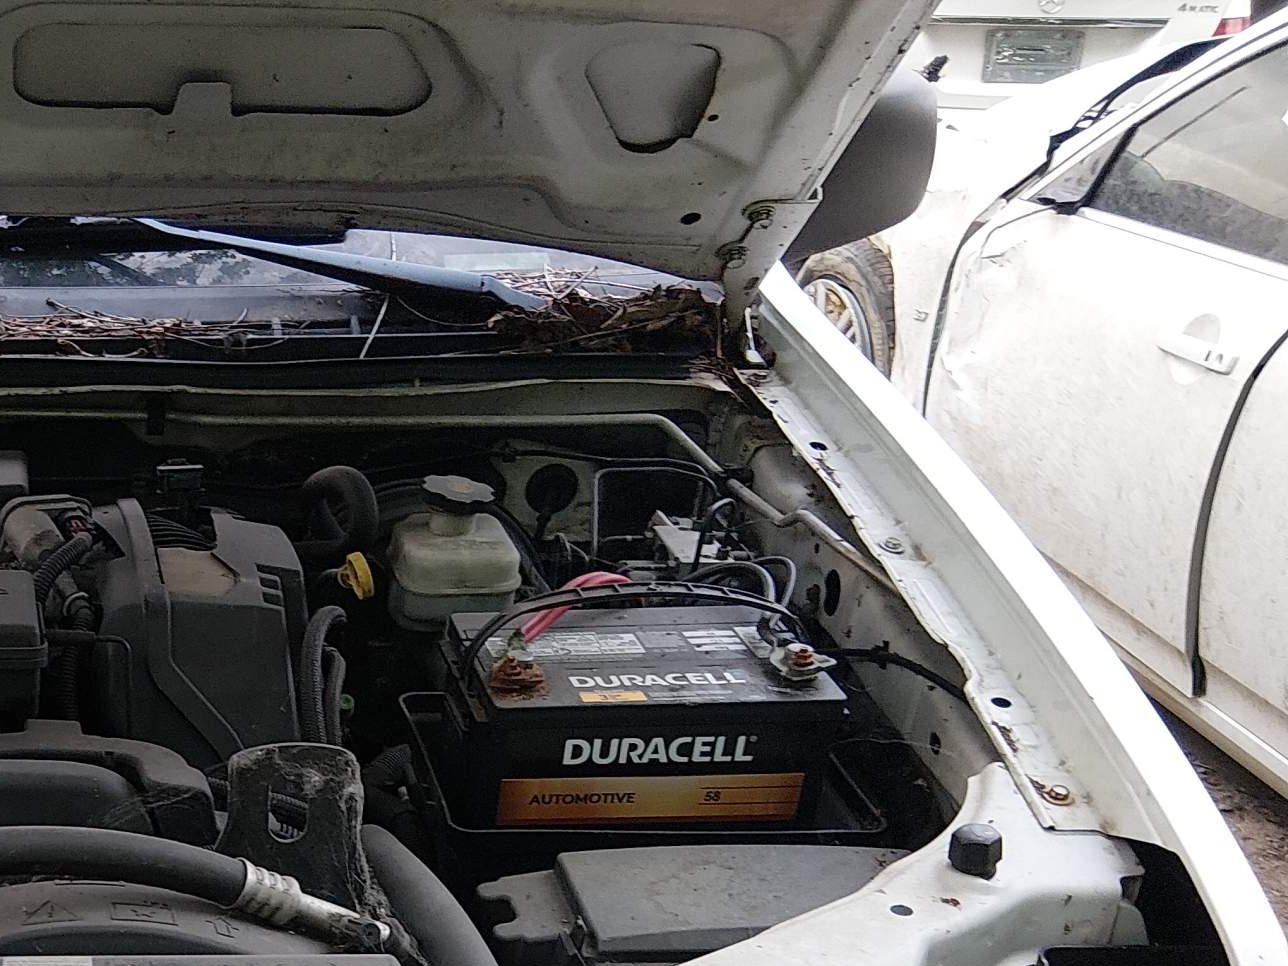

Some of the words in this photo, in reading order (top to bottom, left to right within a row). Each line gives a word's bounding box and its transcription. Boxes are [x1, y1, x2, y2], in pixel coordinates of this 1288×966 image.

[567, 672, 747, 688] DURACELL
[562, 735, 755, 765] DURACELL
[528, 792, 636, 806] AUTOMOTIVE
[703, 790, 721, 802] 58
